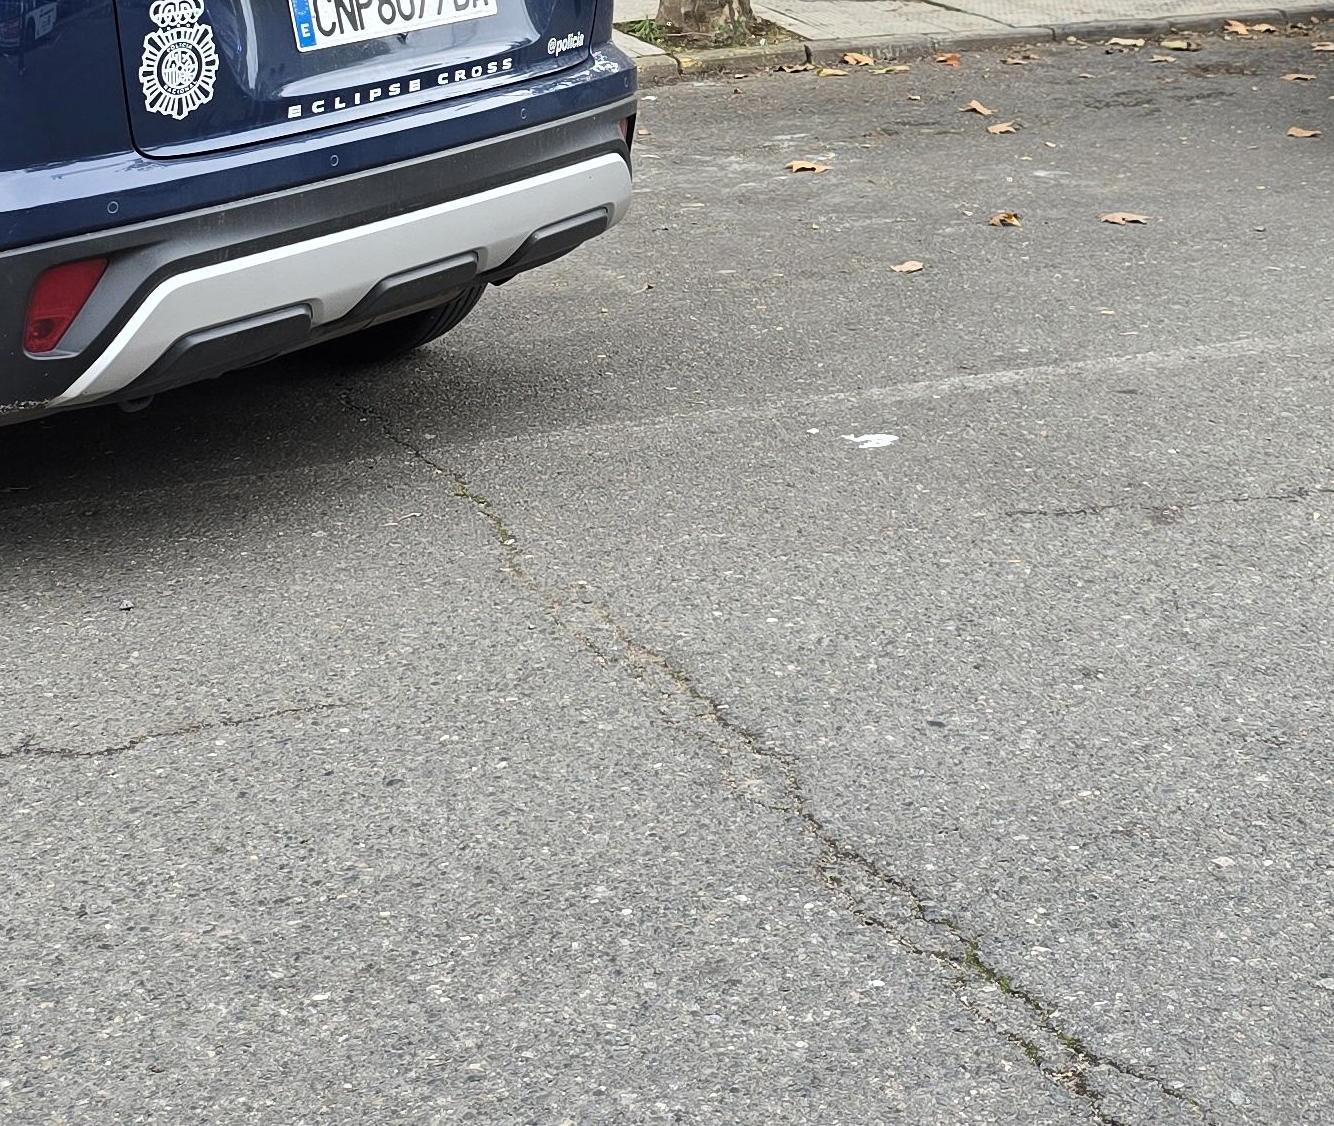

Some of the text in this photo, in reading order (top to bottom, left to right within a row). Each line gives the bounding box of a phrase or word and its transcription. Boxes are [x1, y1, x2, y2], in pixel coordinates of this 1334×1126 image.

[547, 31, 585, 58] @policia
[287, 57, 514, 120] ECLIPSE CROSS
